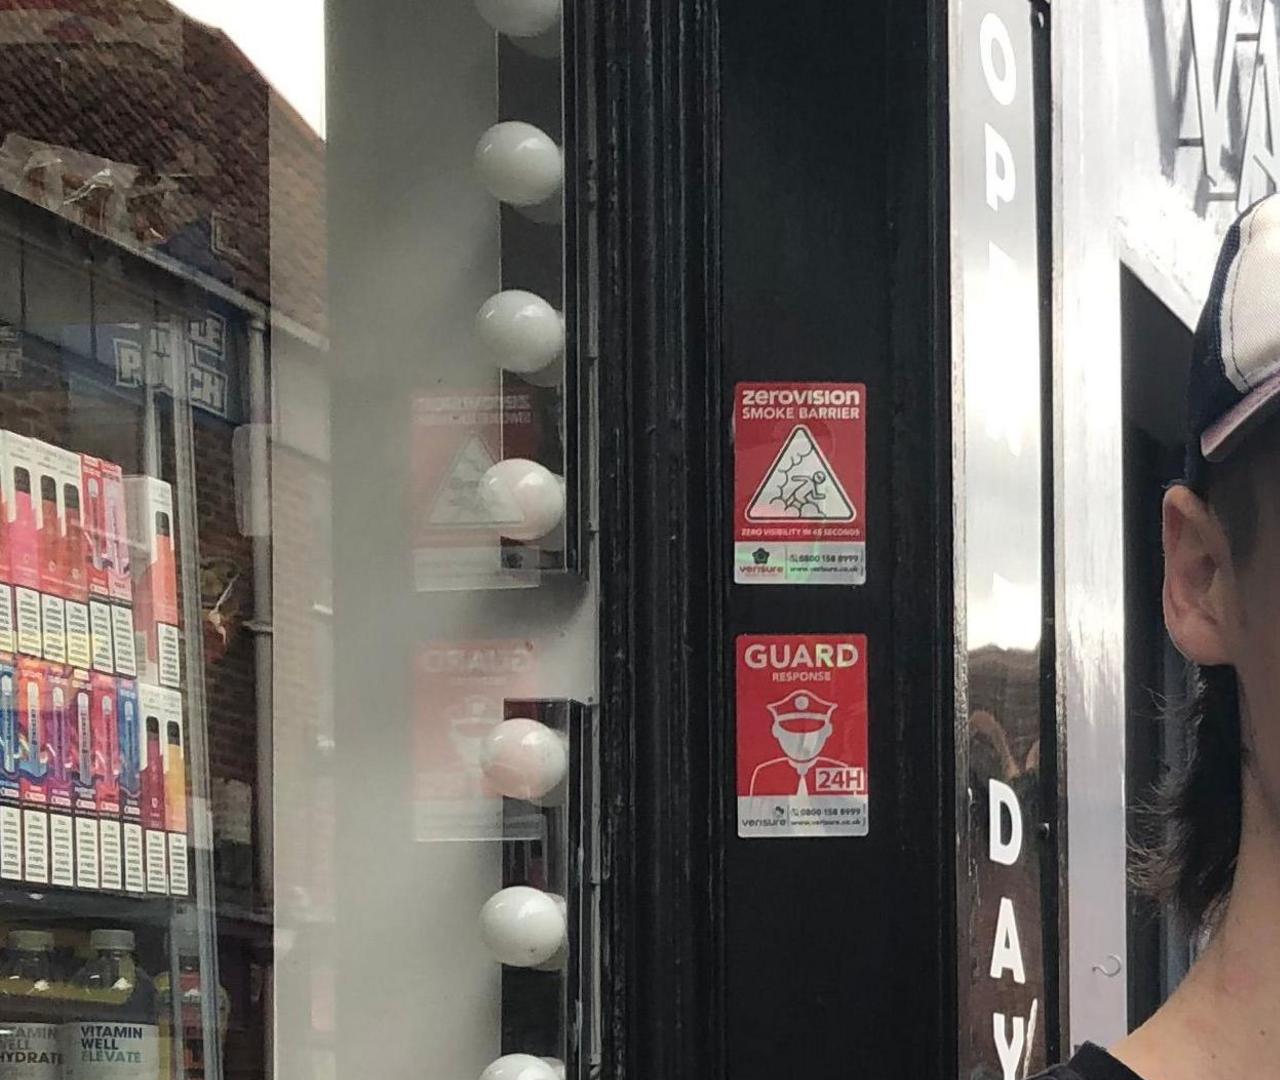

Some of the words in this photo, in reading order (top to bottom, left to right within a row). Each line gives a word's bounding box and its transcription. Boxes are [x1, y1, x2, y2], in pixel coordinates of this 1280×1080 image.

[742, 389, 860, 406] zerovision
[742, 407, 794, 420] SMOKE
[799, 407, 860, 420] BARRIER
[744, 643, 859, 669] GUARD
[772, 671, 832, 682] RESPONSE
[818, 770, 862, 789] 24H
[81, 1025, 143, 1039] VITAMIN
[81, 1038, 119, 1051] WELL
[81, 1051, 142, 1064] ELEVATE
